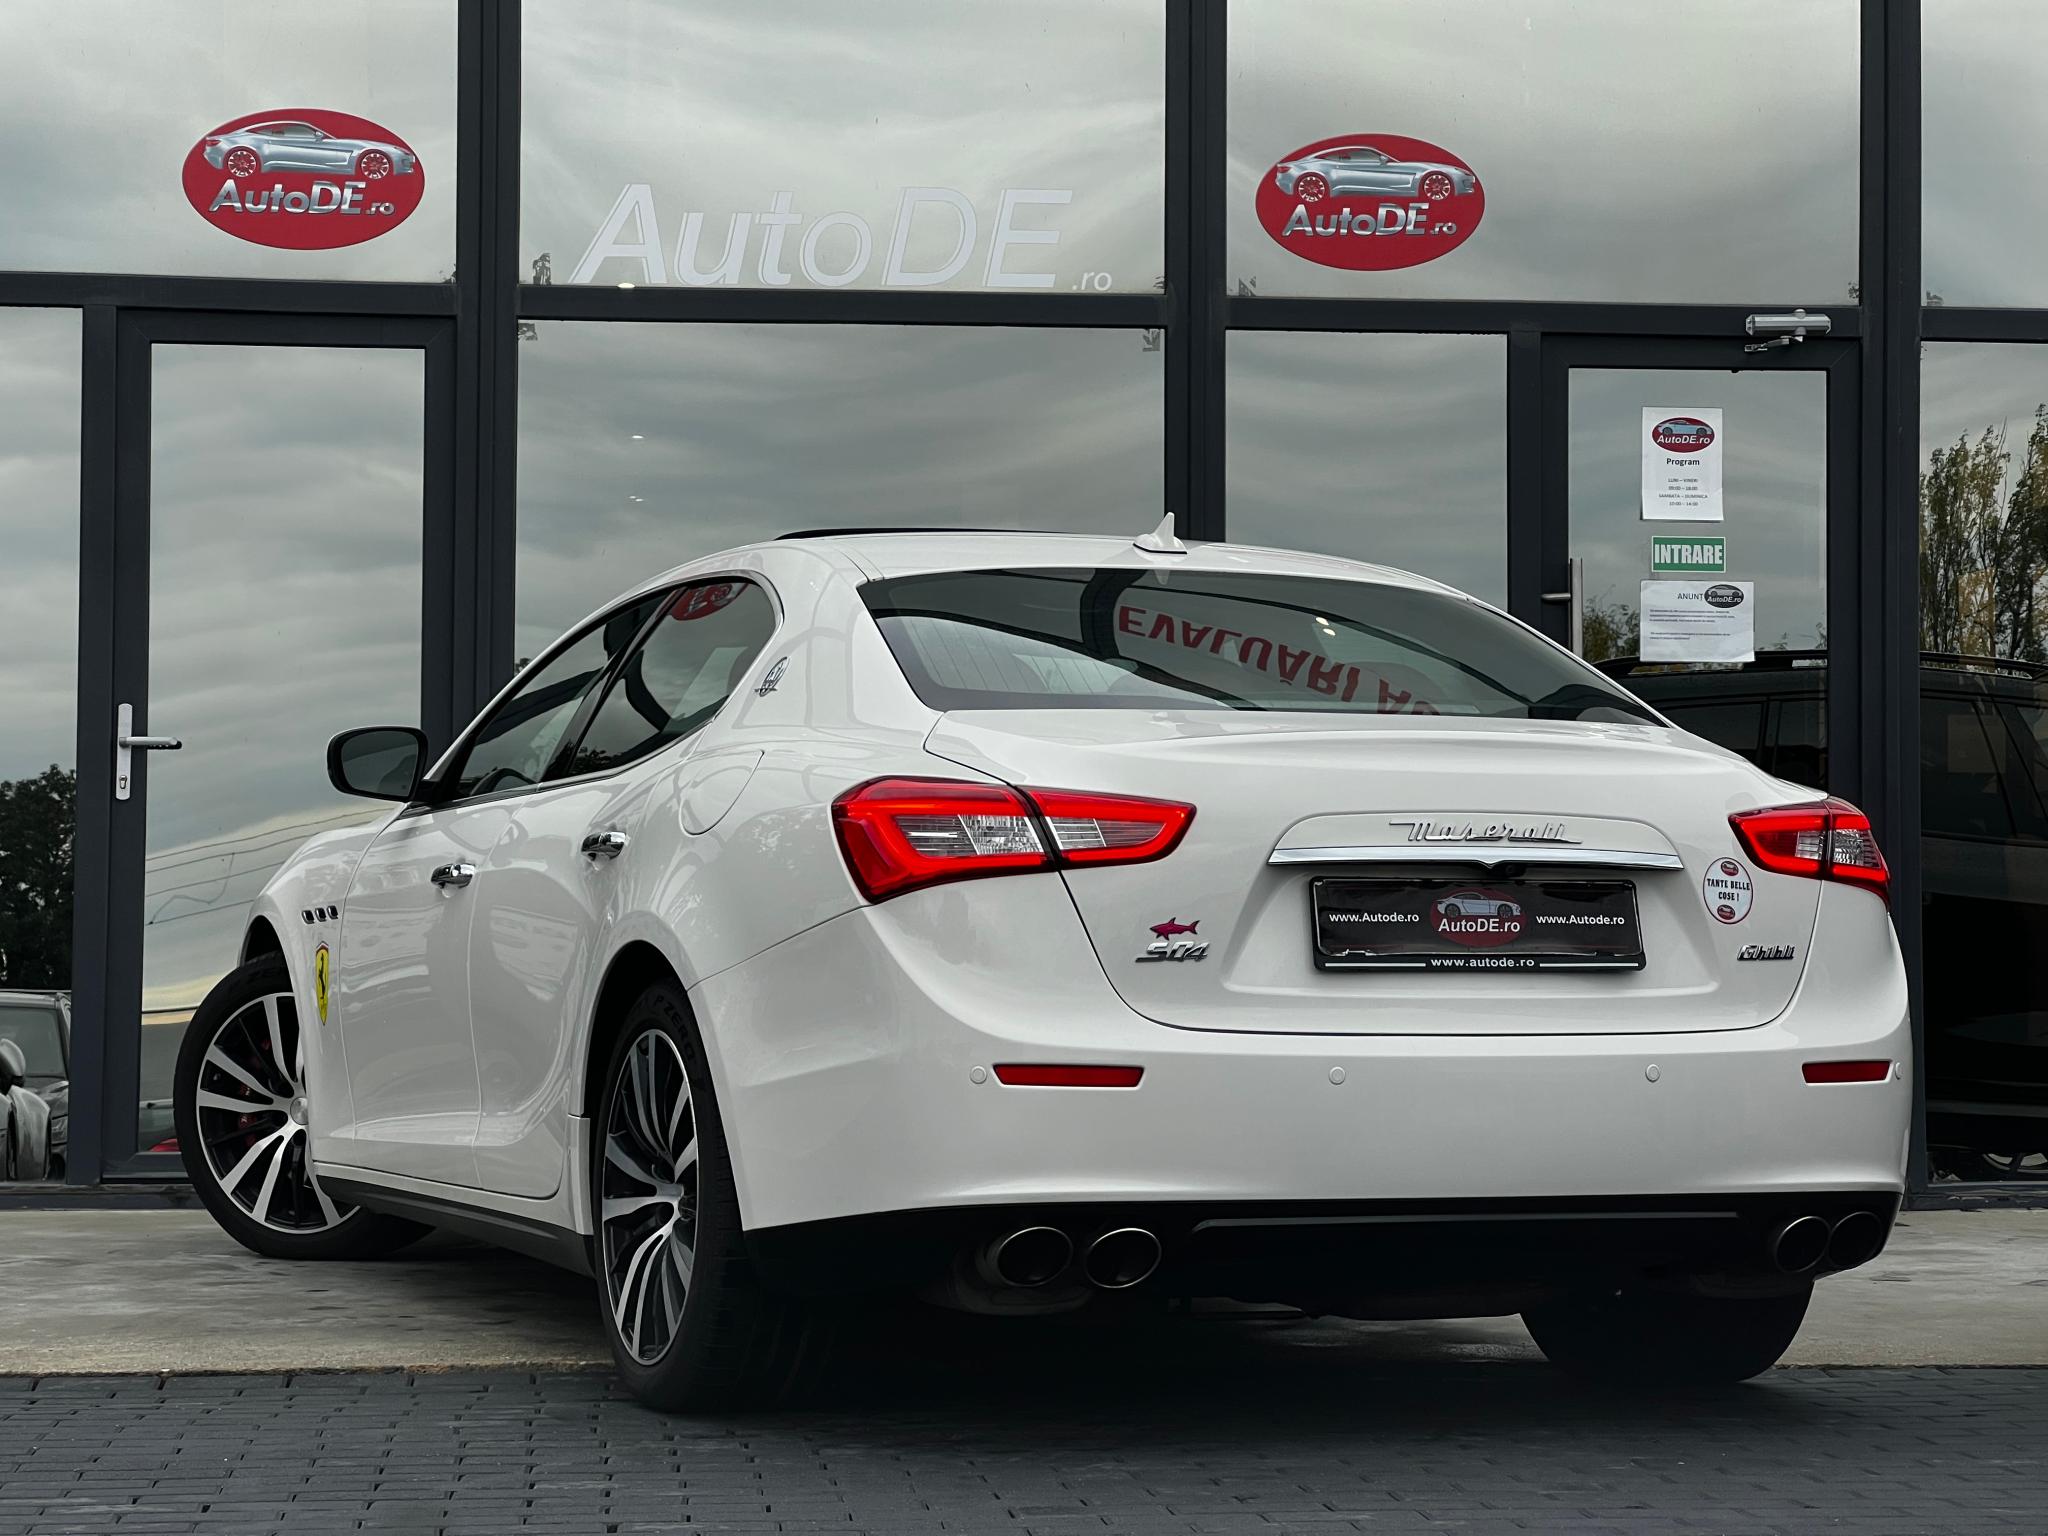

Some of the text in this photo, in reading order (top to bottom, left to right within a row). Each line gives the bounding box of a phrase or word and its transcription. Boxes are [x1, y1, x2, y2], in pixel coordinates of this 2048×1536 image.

[1657, 435, 1711, 444] AutoDE.ro
[1666, 458, 1700, 466] Program
[1654, 544, 1723, 564] INTRARE
[1390, 818, 1583, 844] Maserati
[1706, 878, 1750, 891] TANTE BELLE
[1328, 912, 1419, 923] www.Autode.ro
[1536, 914, 1625, 926] www.Autode.ro
[1438, 918, 1521, 933] AutoDE.ro
[1737, 944, 1795, 961] Ghibli
[1431, 957, 1535, 968] www.autode.ro
